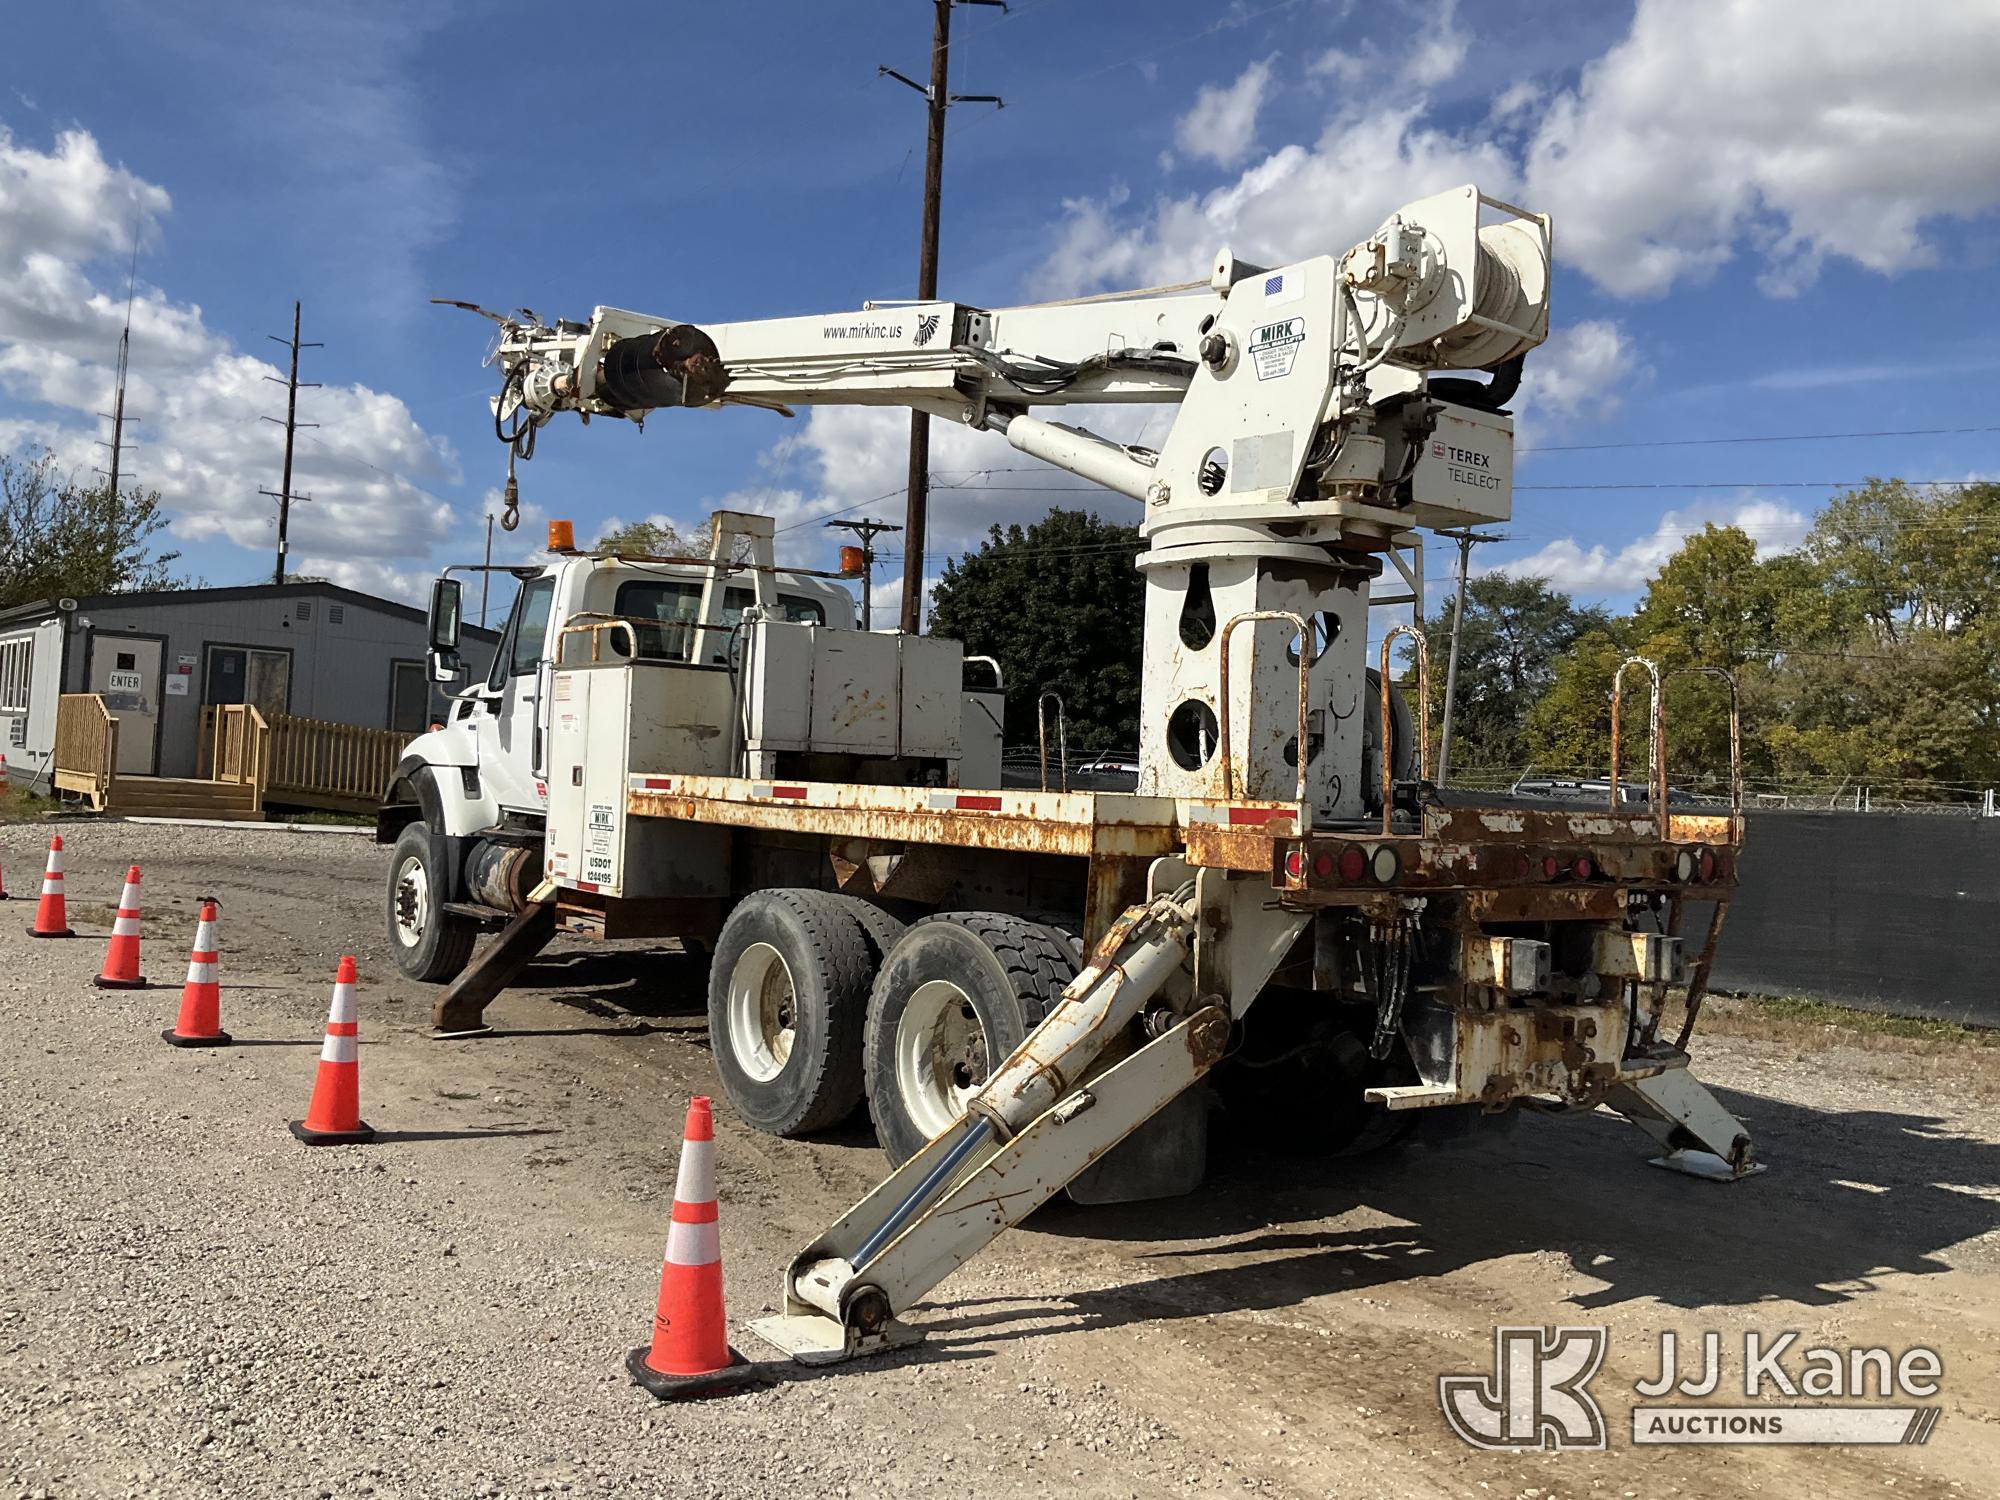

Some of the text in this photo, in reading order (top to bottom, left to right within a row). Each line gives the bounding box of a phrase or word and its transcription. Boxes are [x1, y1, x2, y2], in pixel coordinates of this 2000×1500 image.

[824, 322, 902, 339] www.mirkinc.us
[1261, 322, 1292, 342] MIRK
[1448, 446, 1490, 468] TEREX
[1448, 468, 1501, 490] TELELECT
[111, 675, 139, 688] ENTER
[595, 812, 609, 824] MIRK
[590, 857, 611, 869] USDOT
[588, 871, 611, 883] 1244195
